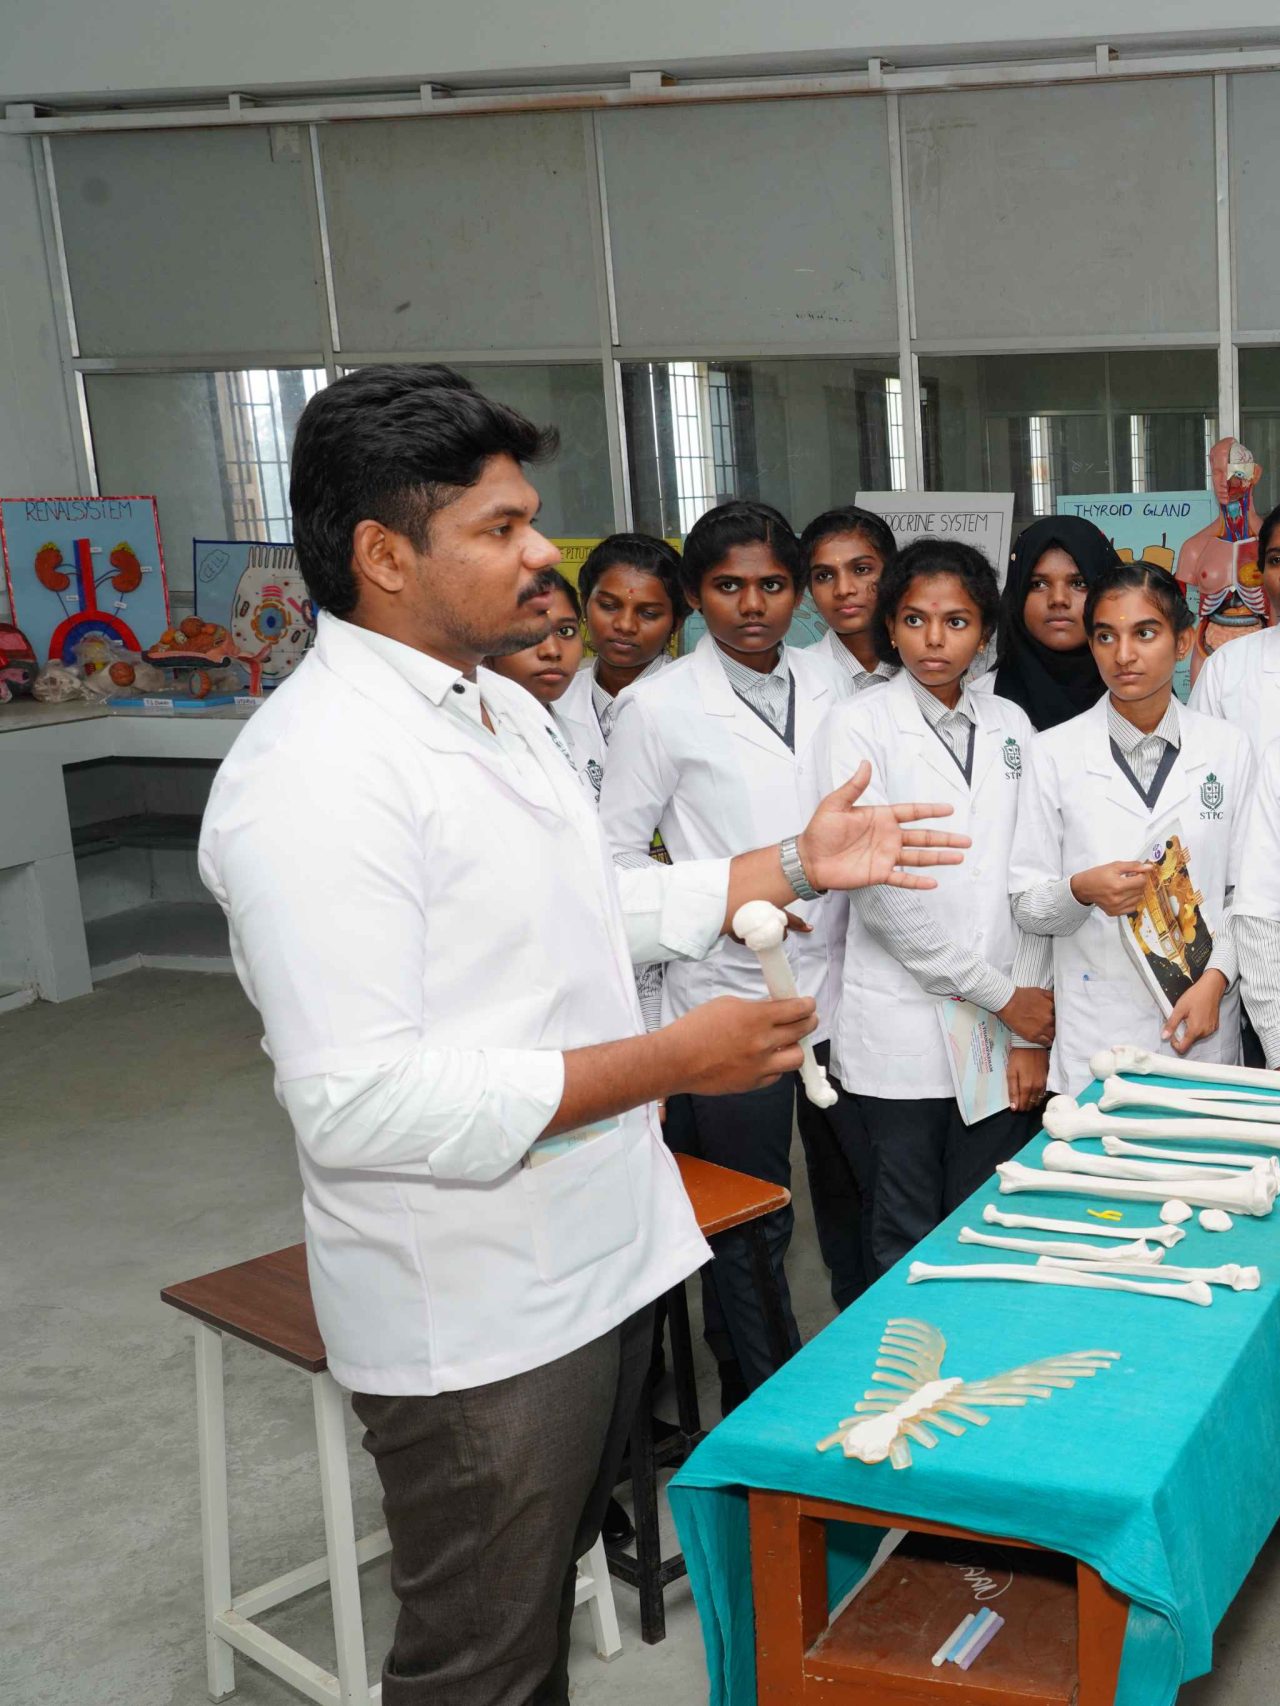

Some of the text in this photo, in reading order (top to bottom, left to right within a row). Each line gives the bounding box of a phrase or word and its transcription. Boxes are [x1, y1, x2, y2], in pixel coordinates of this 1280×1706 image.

[1074, 503, 1191, 518] THYROID GLAND
[940, 513, 989, 532] SYSTEM
[1005, 771, 1022, 780] STP
[1199, 811, 1224, 820] STPC
